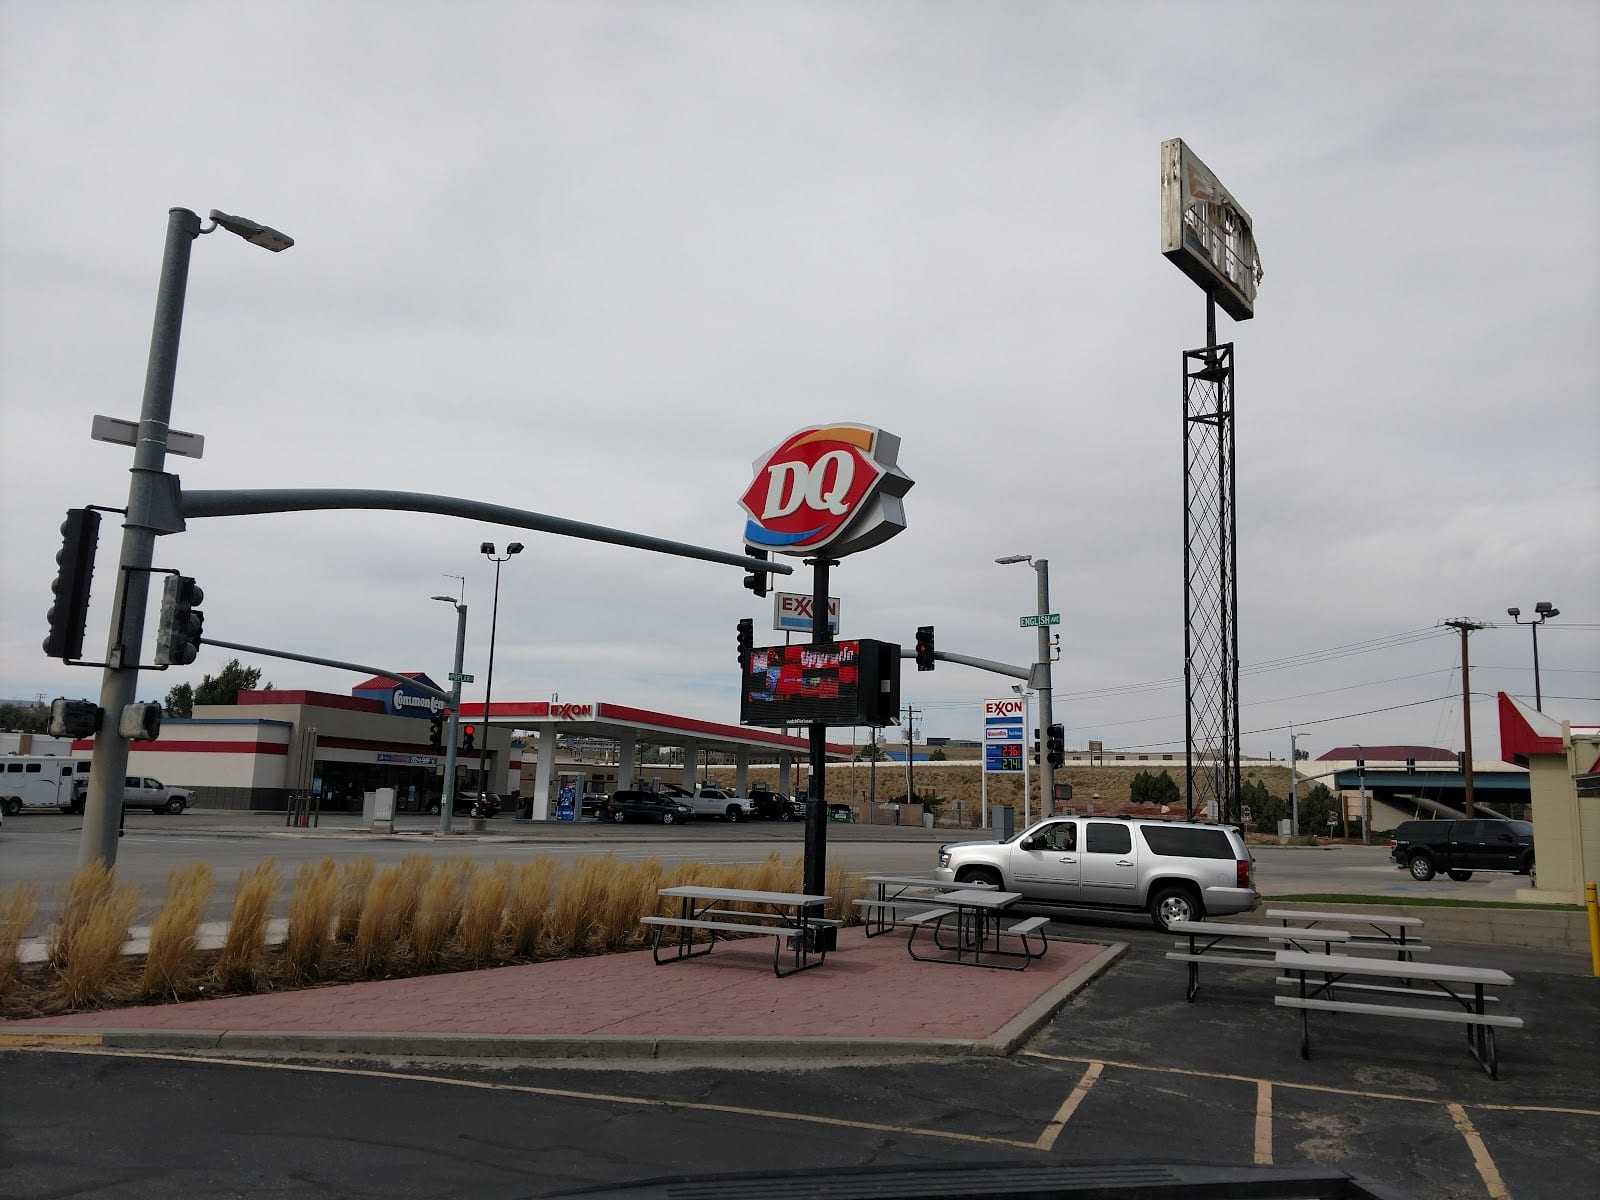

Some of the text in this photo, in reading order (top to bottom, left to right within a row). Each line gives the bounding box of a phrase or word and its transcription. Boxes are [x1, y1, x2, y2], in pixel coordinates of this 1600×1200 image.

[761, 449, 855, 520] DQ
[782, 597, 836, 618] EXXN
[1020, 615, 1050, 627] ENGLISH
[393, 689, 444, 713] Common Cen
[986, 701, 1022, 716] EXXON
[550, 703, 591, 720] EXXON
